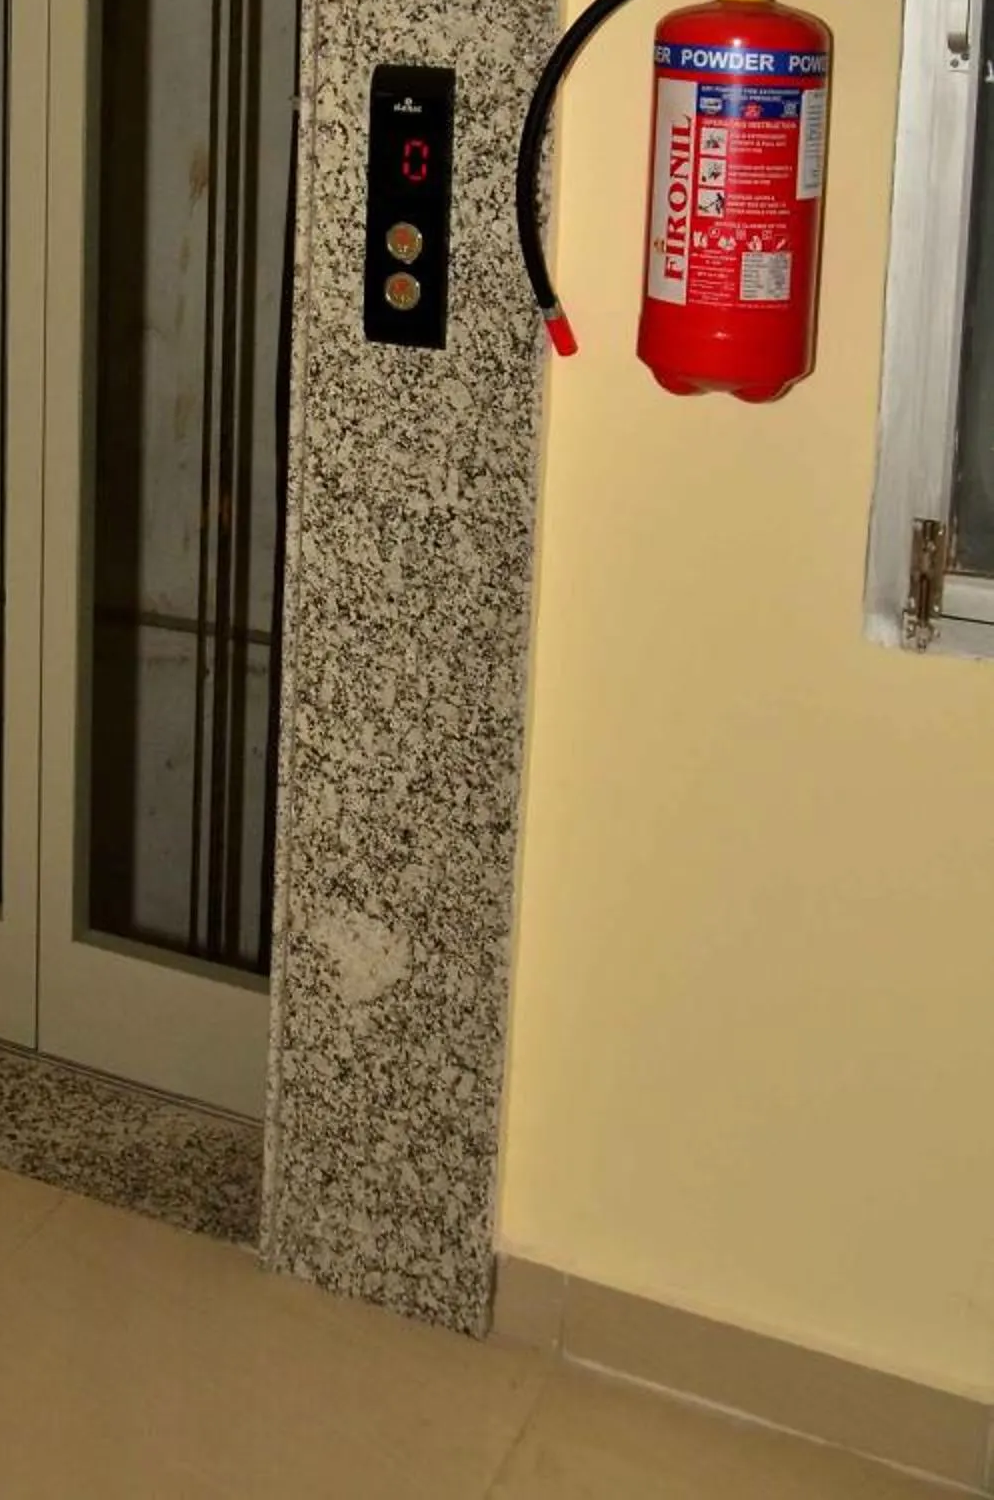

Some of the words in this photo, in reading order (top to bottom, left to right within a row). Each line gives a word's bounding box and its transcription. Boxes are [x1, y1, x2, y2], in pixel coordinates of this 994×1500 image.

[681, 49, 774, 71] POWDER
[403, 139, 430, 181] 0
[664, 116, 692, 279] FIRONIL
